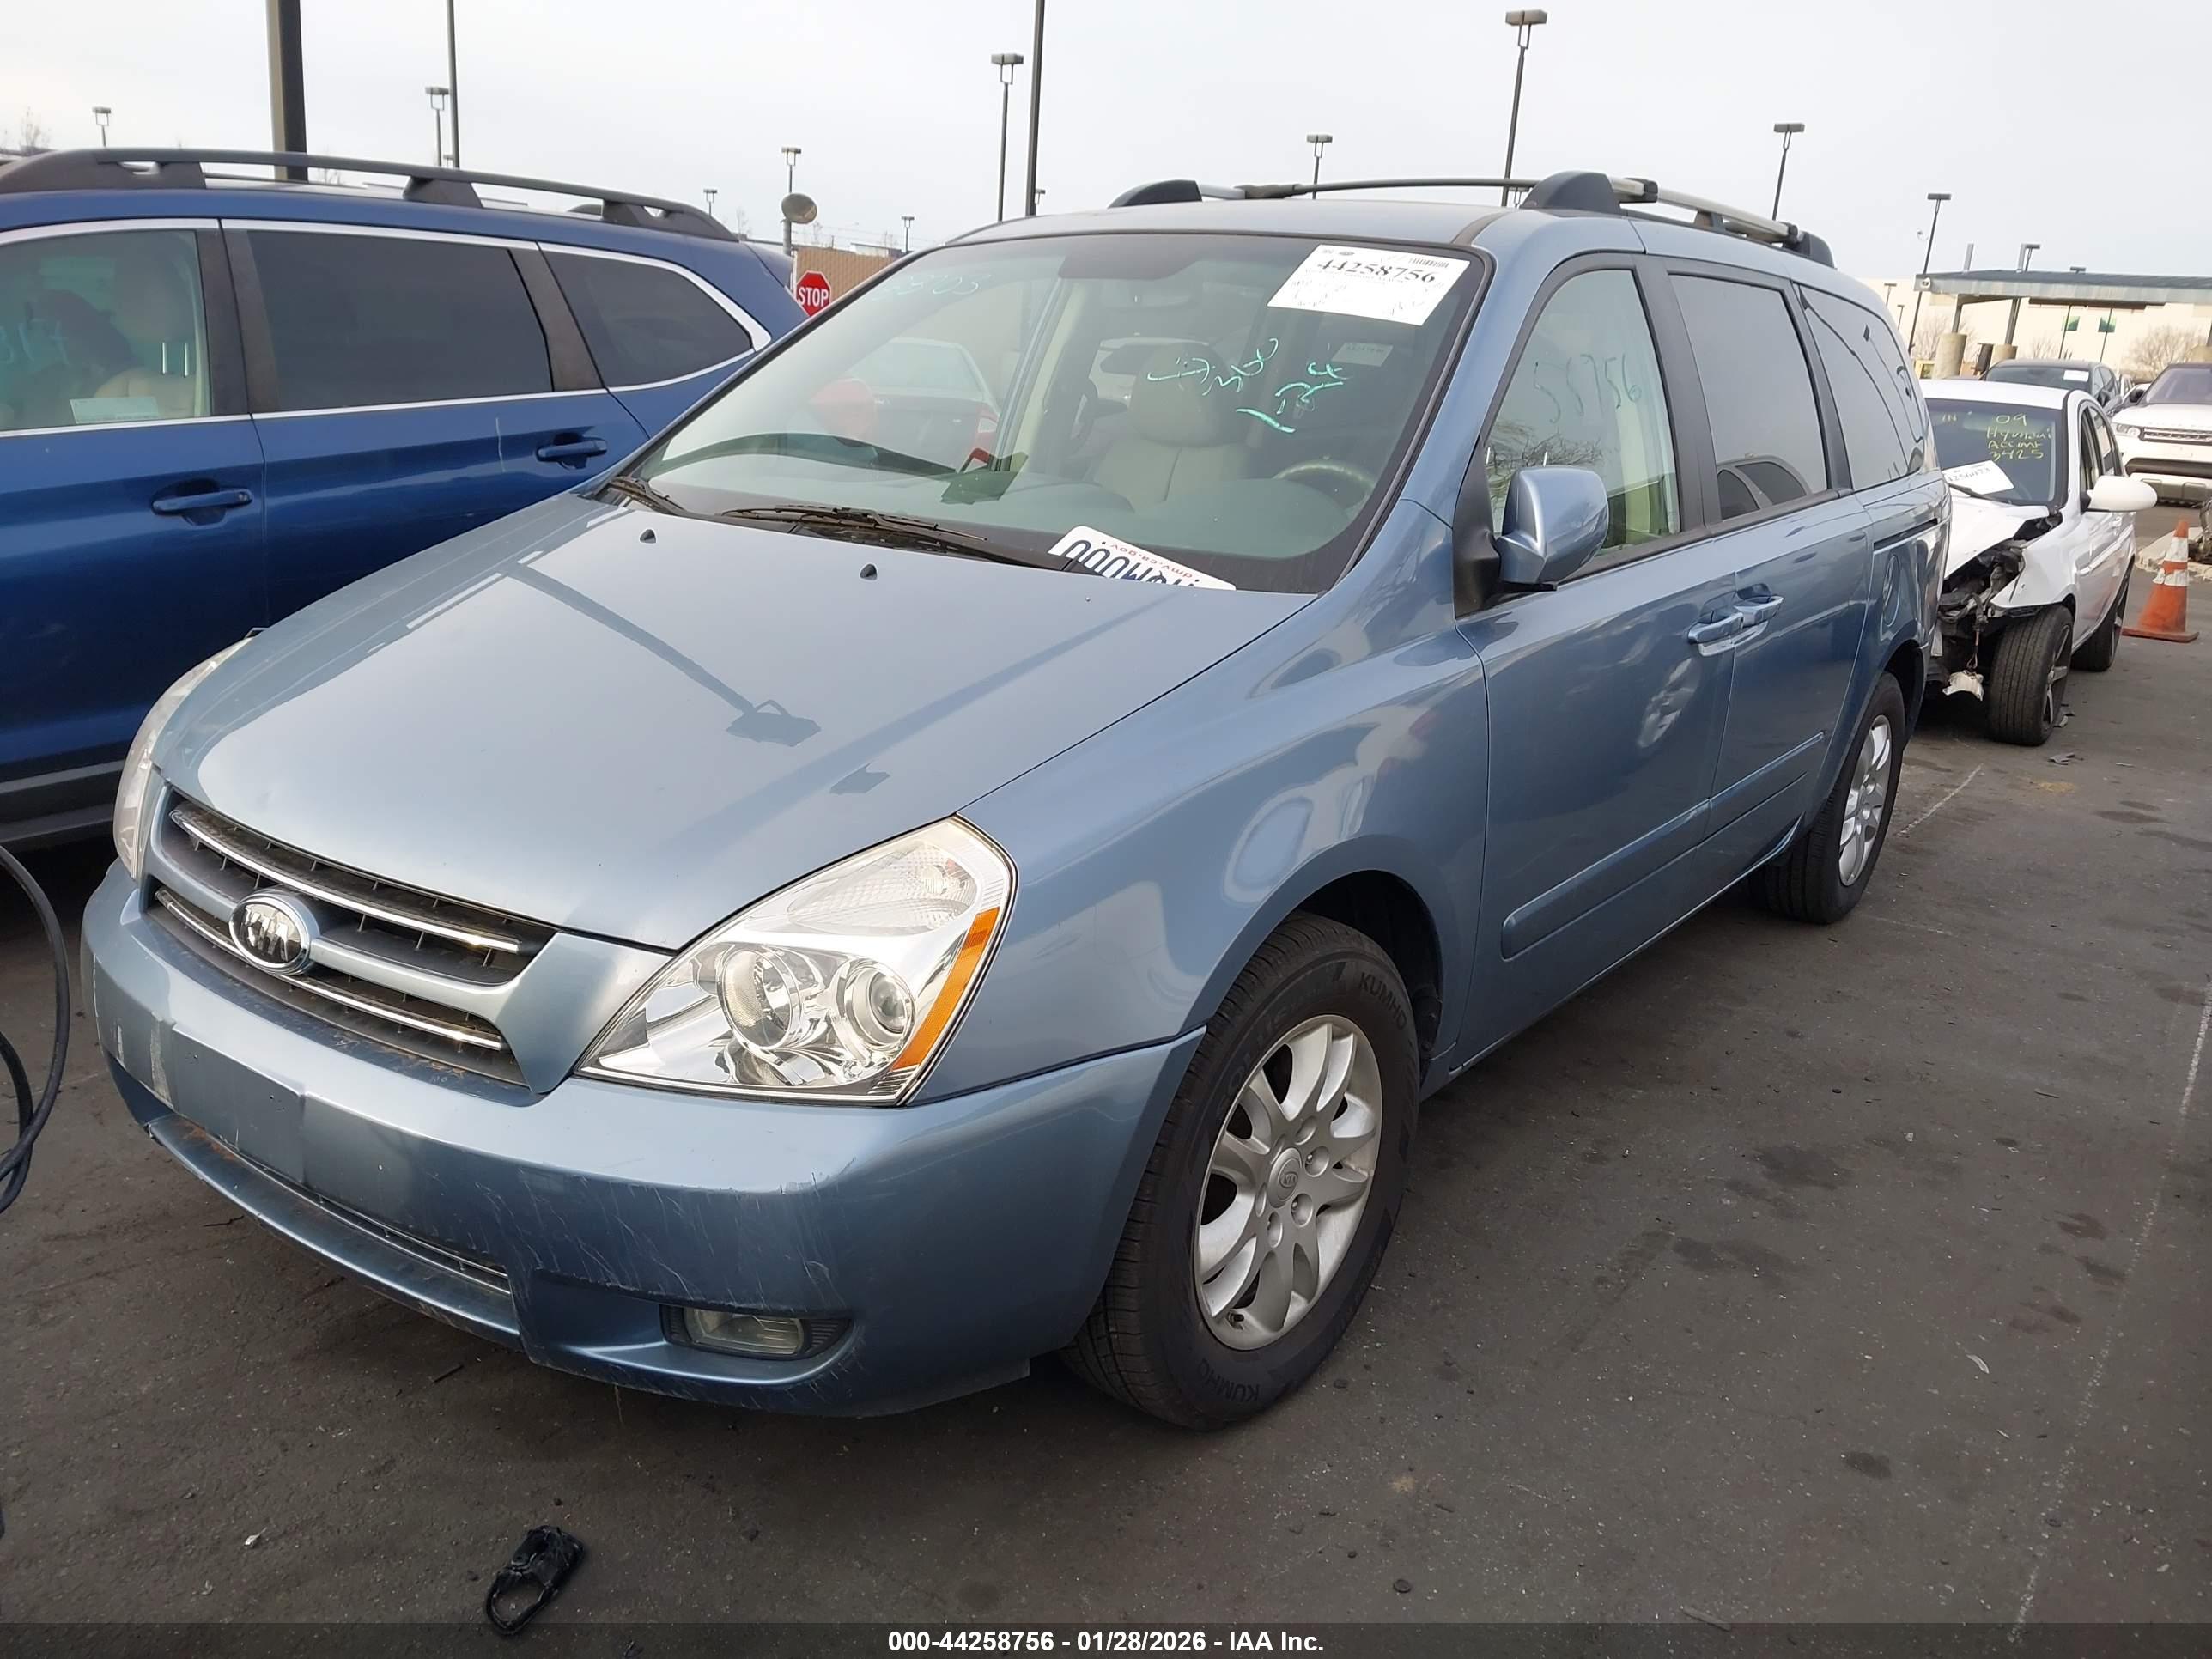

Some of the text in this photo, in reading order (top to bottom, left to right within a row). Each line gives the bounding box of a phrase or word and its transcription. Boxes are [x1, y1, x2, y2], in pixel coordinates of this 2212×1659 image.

[1316, 258, 1436, 283] 44258756
[798, 286, 830, 307] STOP
[1996, 413, 2027, 427] 09
[1989, 448, 2045, 462] 3425
[1110, 543, 1194, 580] dmv.ca.gov
[1359, 971, 1407, 1030] KUMHO
[1197, 1358, 1261, 1403] KUMHO
